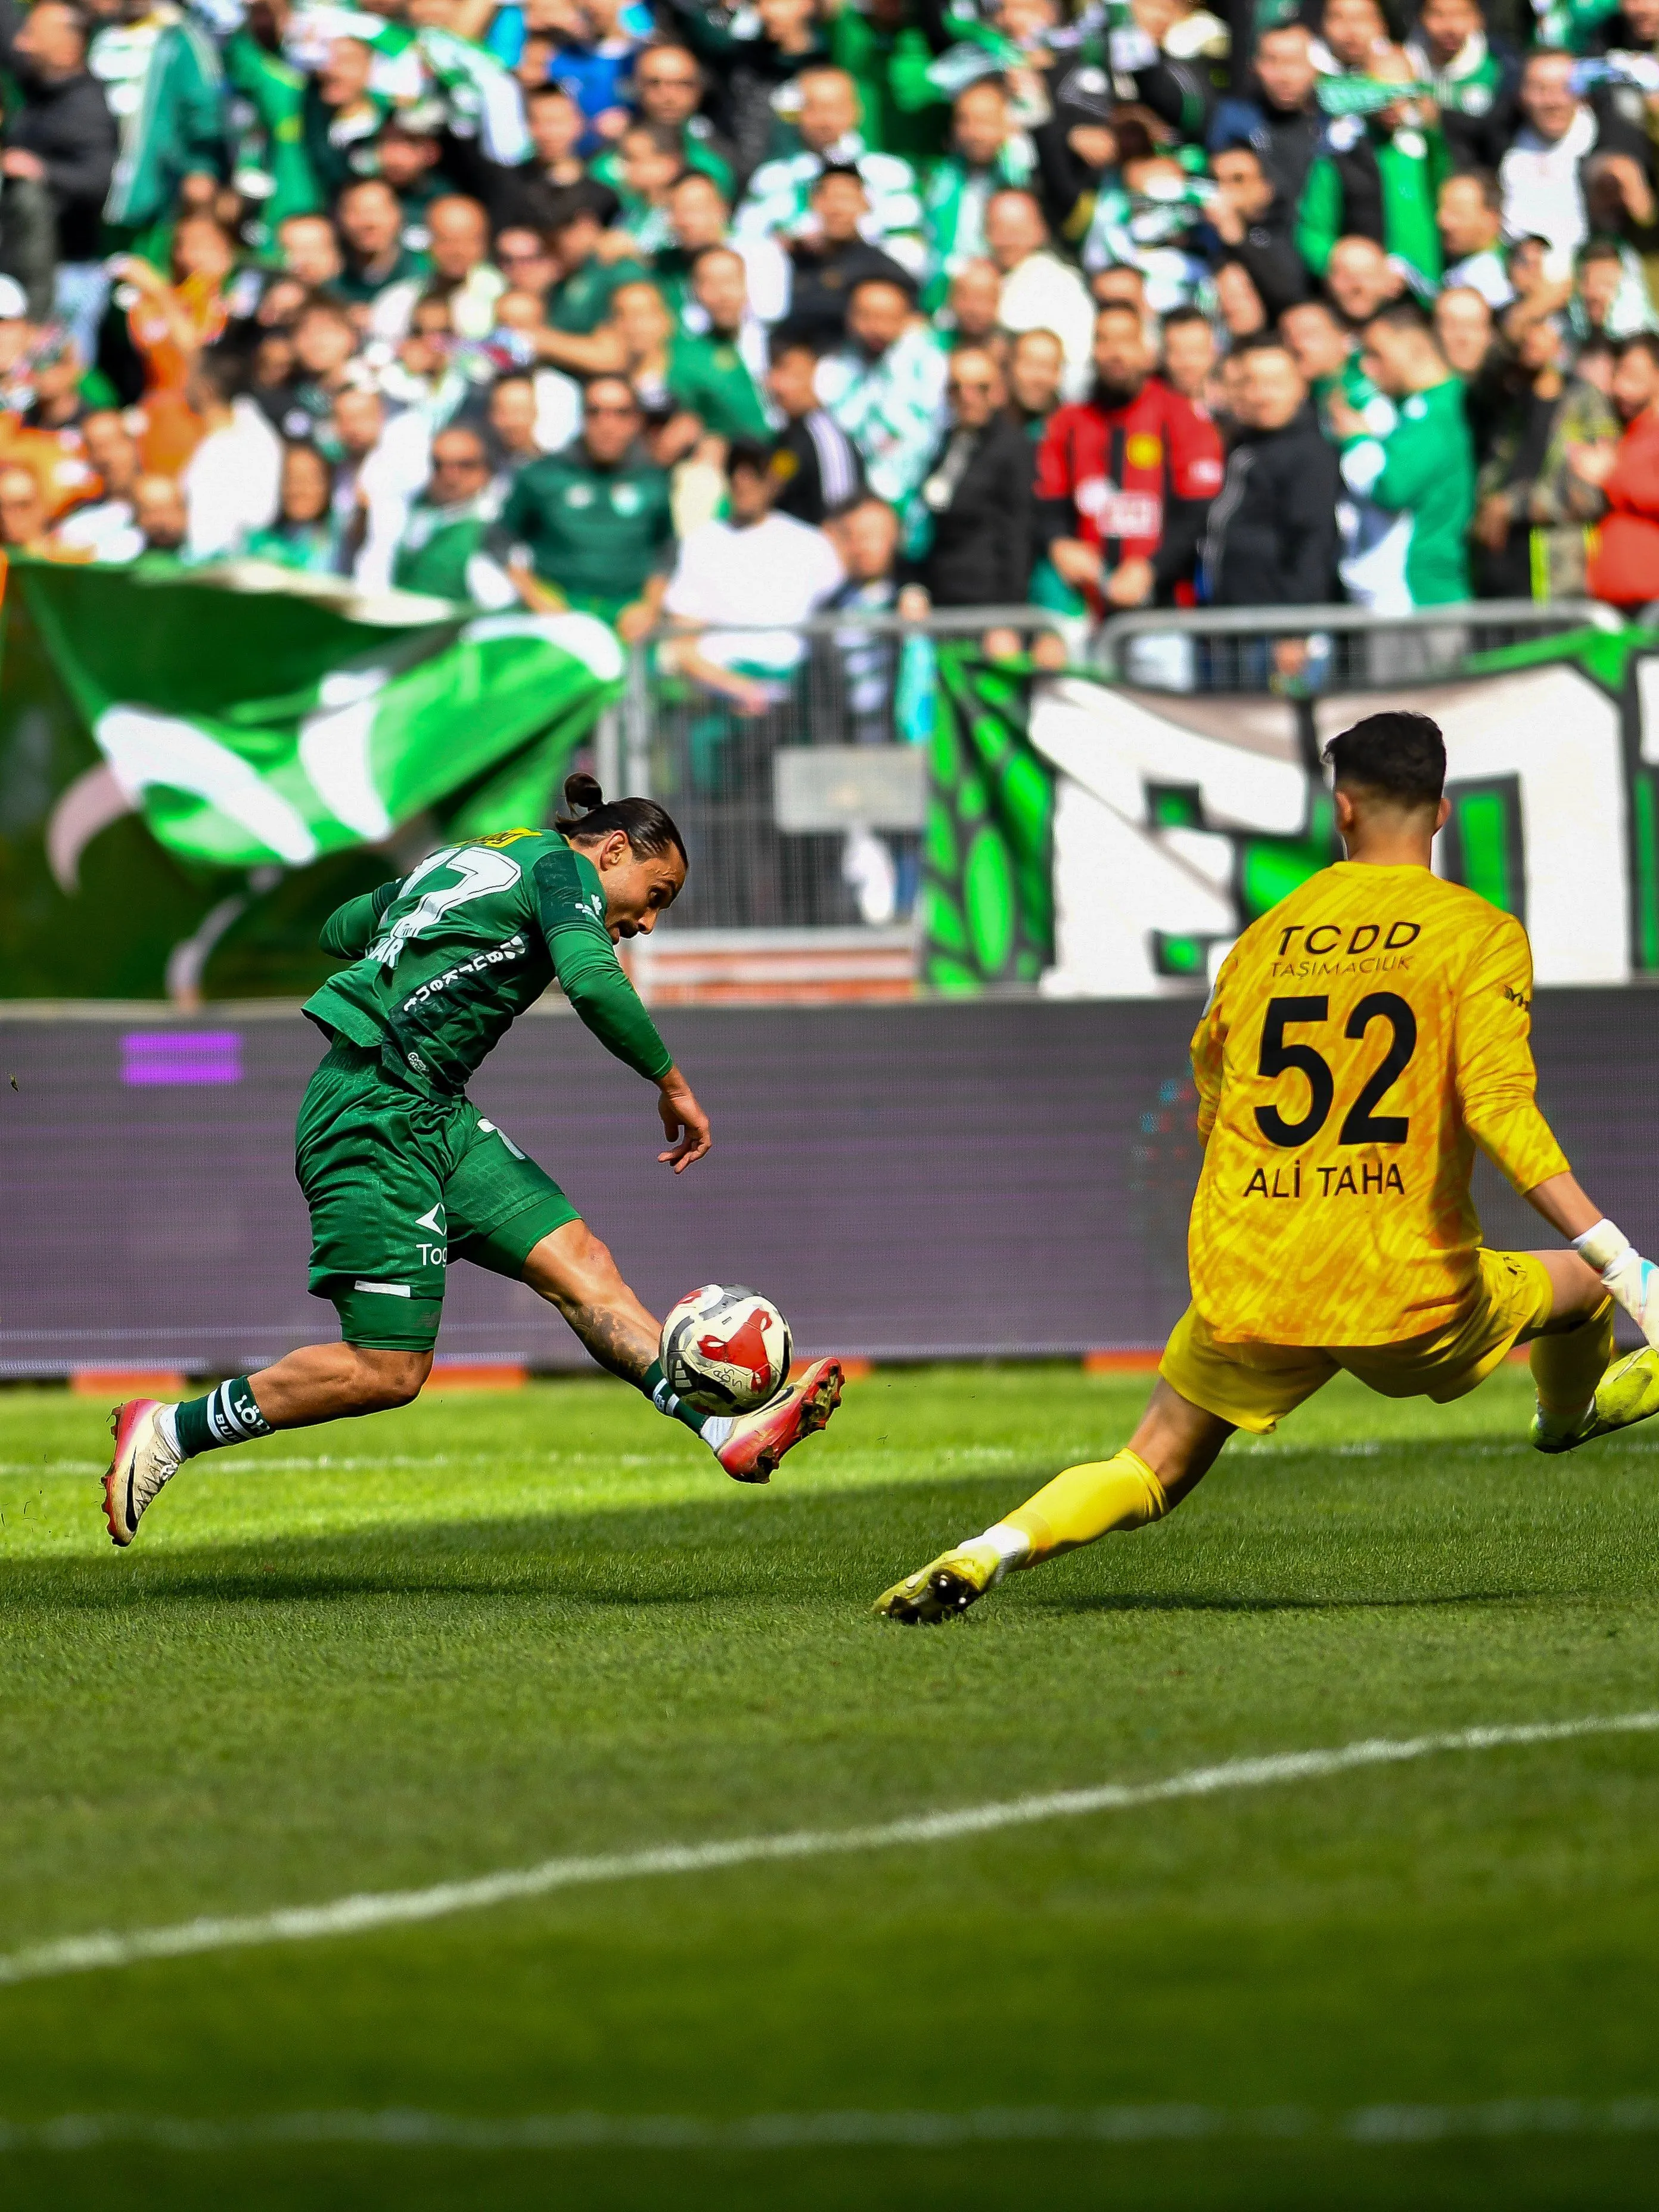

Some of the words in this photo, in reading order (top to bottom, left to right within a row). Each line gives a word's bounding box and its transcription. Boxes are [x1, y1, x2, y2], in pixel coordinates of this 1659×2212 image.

[1278, 921, 1421, 956] TCDD
[403, 950, 504, 1012] Burkent
[1253, 990, 1418, 1148] 52
[1242, 1159, 1301, 1198] ALİ
[1315, 1162, 1405, 1195] TAHA
